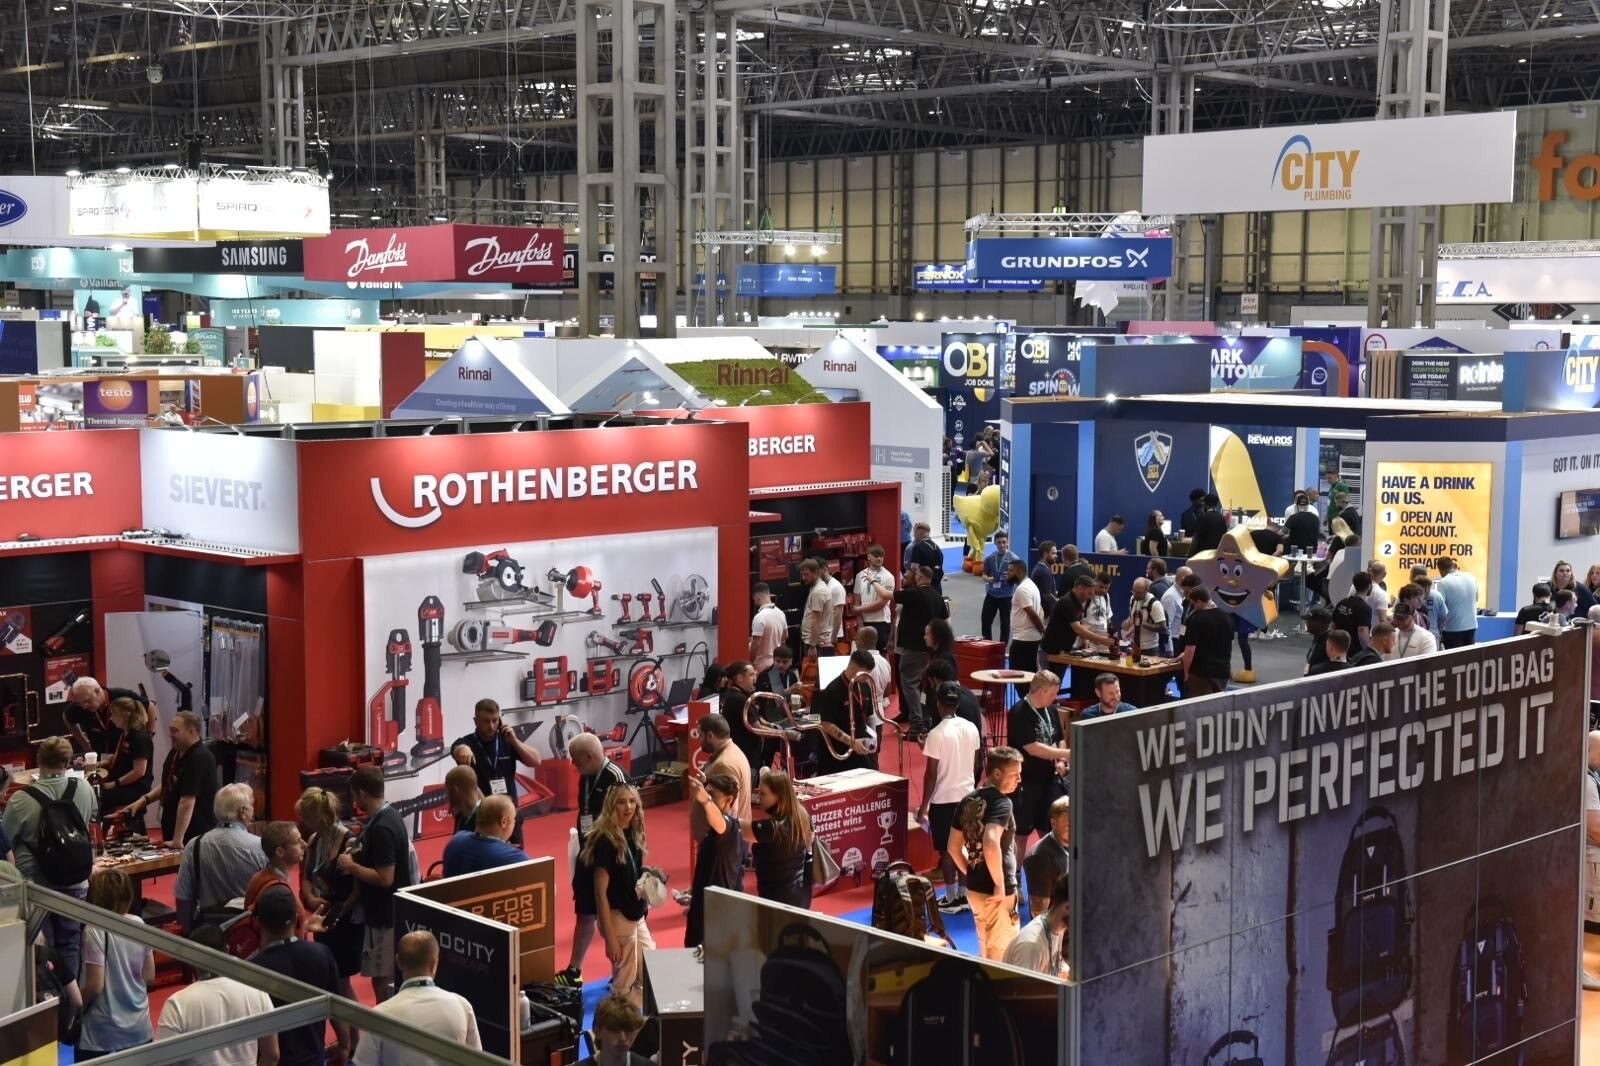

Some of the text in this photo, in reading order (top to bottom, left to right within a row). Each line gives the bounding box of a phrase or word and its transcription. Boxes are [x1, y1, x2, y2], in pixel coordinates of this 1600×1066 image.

[1281, 149, 1360, 191] CITY
[1304, 190, 1352, 201] PLUMBING
[222, 246, 287, 266] SAMSUNG
[344, 233, 408, 277] Danfoss
[464, 232, 554, 276] Danfoss
[1001, 255, 1123, 269] GRUNDFOS
[917, 270, 965, 280] FERNOX
[1021, 339, 1050, 359] OB1
[823, 360, 857, 372] Rinnai
[944, 341, 996, 377] OB1
[458, 367, 492, 381] Rinnai
[717, 363, 788, 386] Rinnai
[1565, 355, 1600, 386] CITY
[977, 379, 994, 387] DONE
[99, 387, 133, 398] testo
[86, 417, 147, 426] Thermal Imaging
[749, 434, 816, 457] BERGER
[1247, 435, 1293, 445] REWARDS
[1553, 457, 1568, 473] GOT
[1580, 454, 1592, 470] ON
[413, 459, 698, 508] ROTHENBERGER
[1381, 476, 1475, 490] HAVE A DRINK
[1381, 492, 1425, 505] ON US.
[1386, 511, 1453, 524] 1 OPEN AN
[1400, 525, 1458, 538] ACCOUNT.
[1384, 543, 1473, 556] 2 SIGN UP FOR
[1136, 648, 1554, 772] WE DIDN’T INVENT THE TOOLBAG
[1138, 691, 1554, 858] WE PERFECTED IT
[811, 798, 892, 824] BUZZER CHALLENGE
[843, 816, 862, 826] wins
[493, 894, 533, 915] FOR
